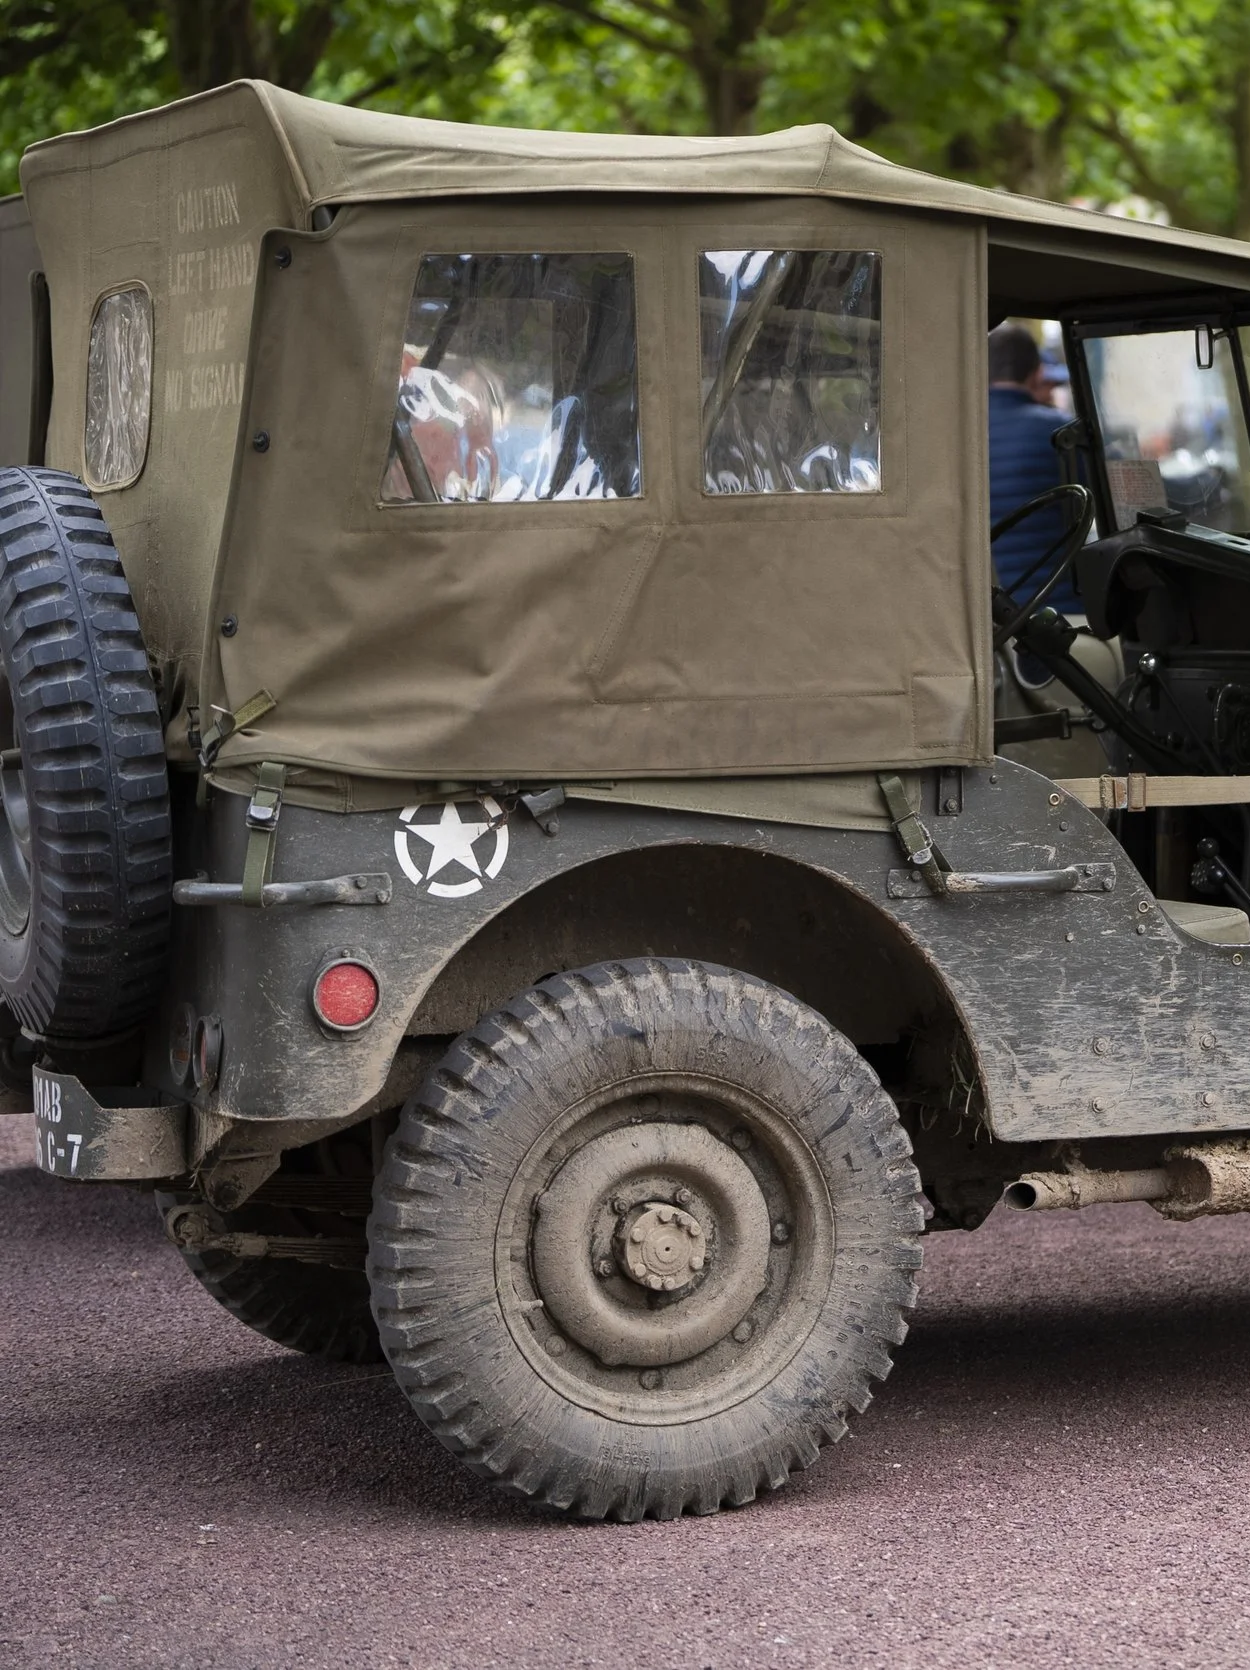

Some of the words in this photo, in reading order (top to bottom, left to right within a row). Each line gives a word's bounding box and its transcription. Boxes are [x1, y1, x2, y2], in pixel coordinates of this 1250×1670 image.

[177, 182, 240, 234] CAUTION
[167, 250, 206, 296] LEFT
[209, 243, 255, 291] HAND
[183, 306, 229, 354] DRIVE
[165, 369, 184, 413] NO
